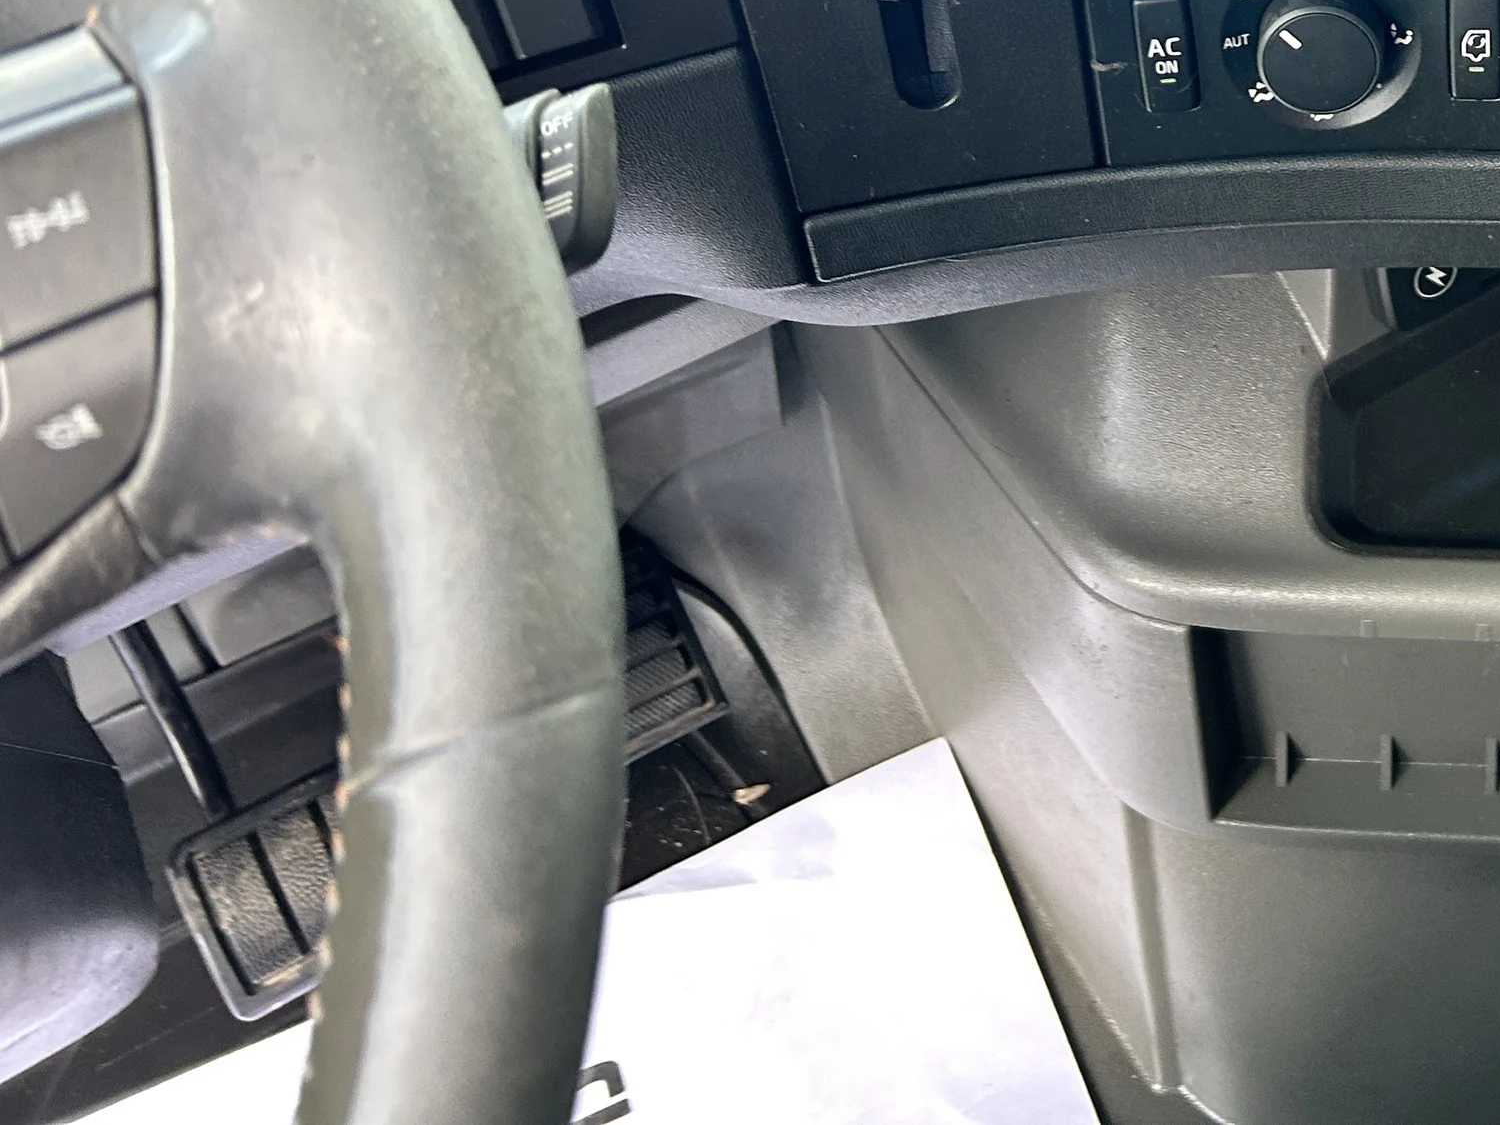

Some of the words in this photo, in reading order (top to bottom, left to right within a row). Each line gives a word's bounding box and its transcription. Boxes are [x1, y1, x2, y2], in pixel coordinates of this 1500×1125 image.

[1147, 36, 1182, 59] AC
[1223, 33, 1250, 50] AUT
[1155, 59, 1179, 74] ON
[541, 111, 573, 137] OFF
